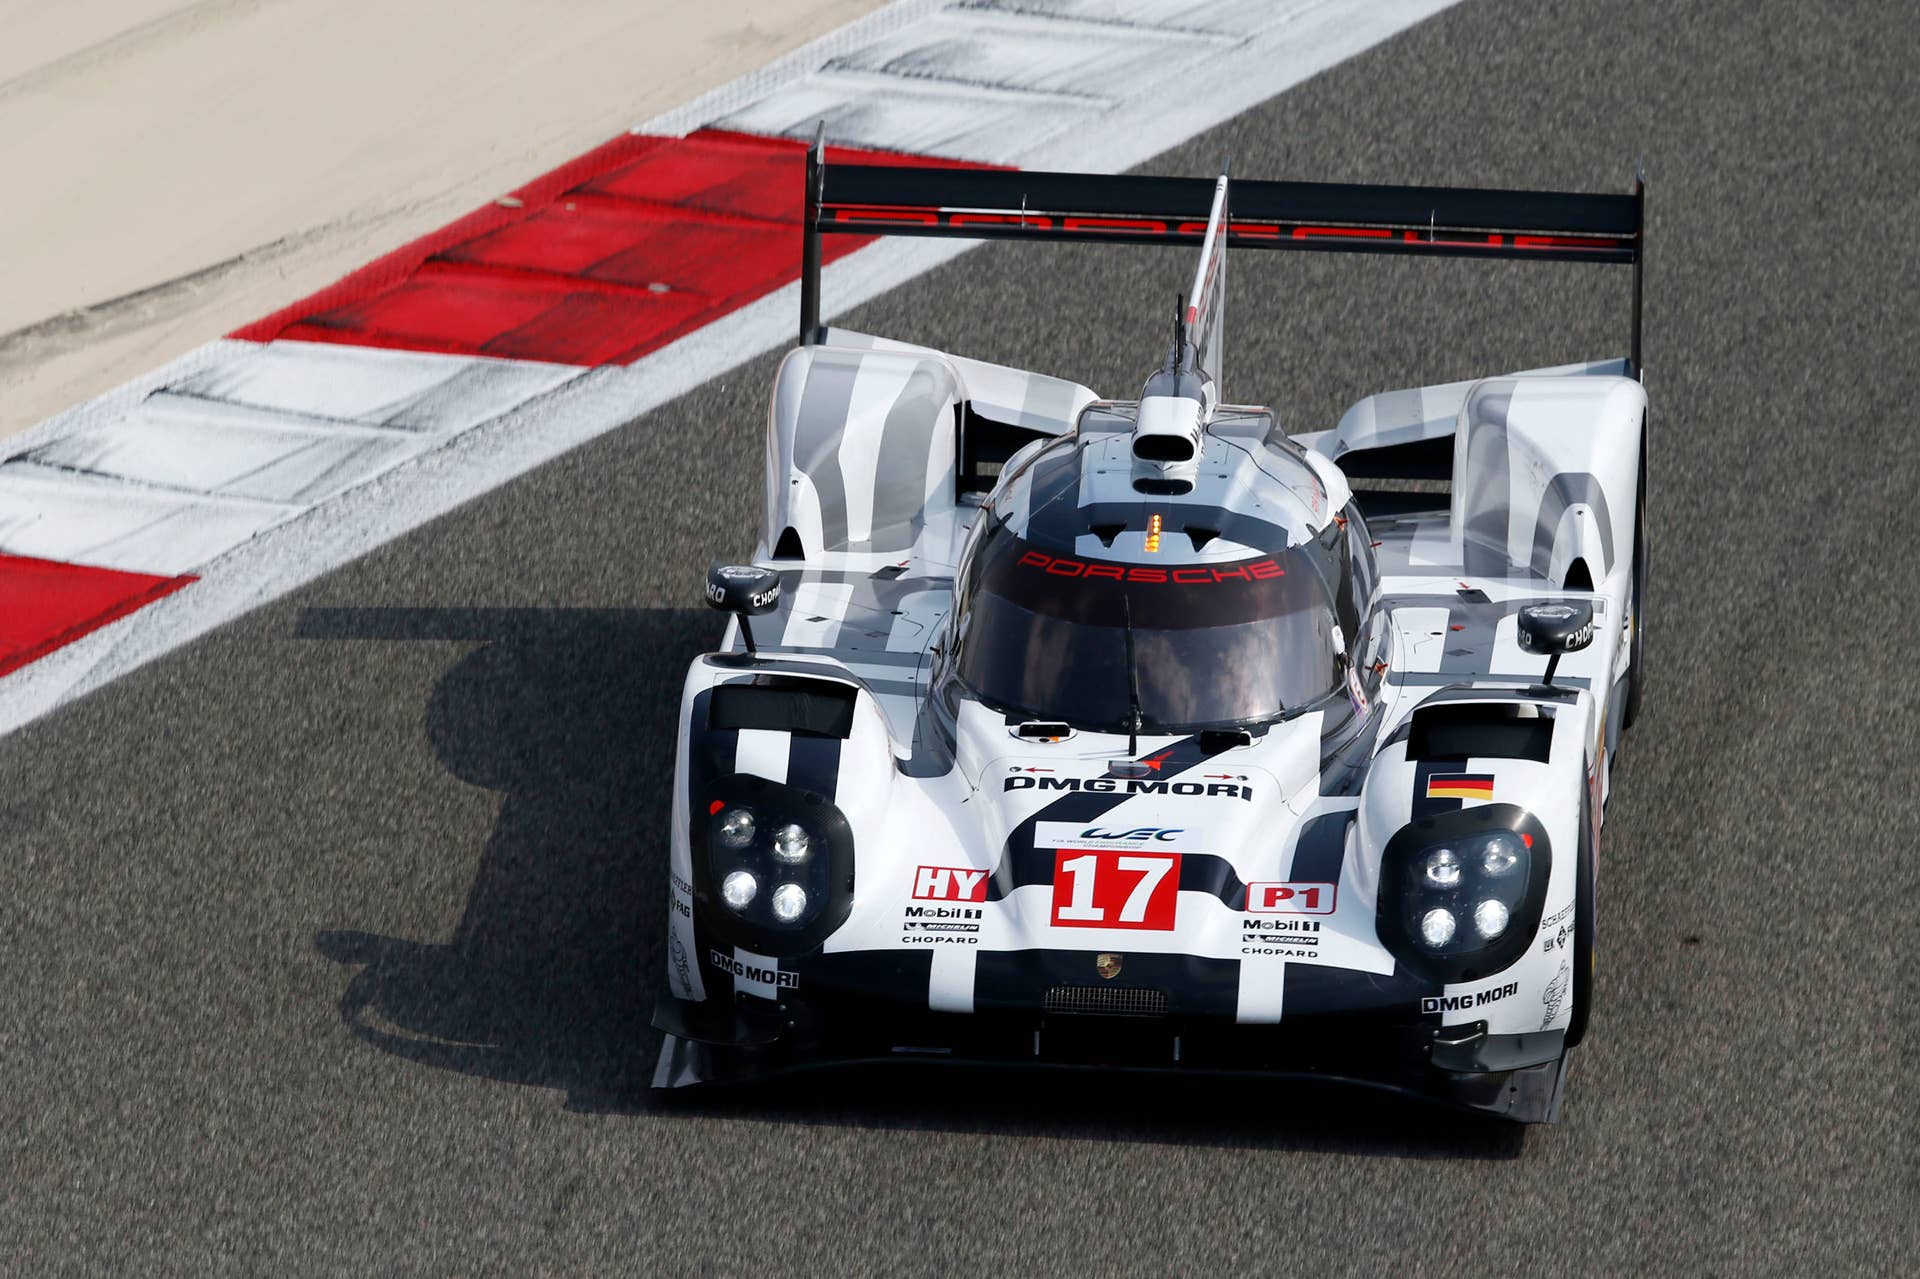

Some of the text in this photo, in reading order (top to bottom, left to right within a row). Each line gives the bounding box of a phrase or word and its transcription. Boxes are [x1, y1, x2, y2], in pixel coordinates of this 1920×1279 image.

[1017, 551, 1286, 584] PORSCHE
[1003, 775, 1253, 802] DMG MORI
[1080, 827, 1185, 842] WEC
[915, 867, 986, 900] HY
[1057, 854, 1175, 923] 17
[1263, 887, 1320, 908] P1
[905, 906, 961, 919] Mobil
[926, 923, 979, 931] MICHELIN
[1243, 920, 1298, 931] Mobil
[902, 936, 978, 944] CHOPARD
[1264, 935, 1318, 944] MICHELIN
[1241, 947, 1318, 958] CHOPARD
[711, 951, 799, 988] DMG MORI
[1422, 981, 1519, 1013] DMG MORI
